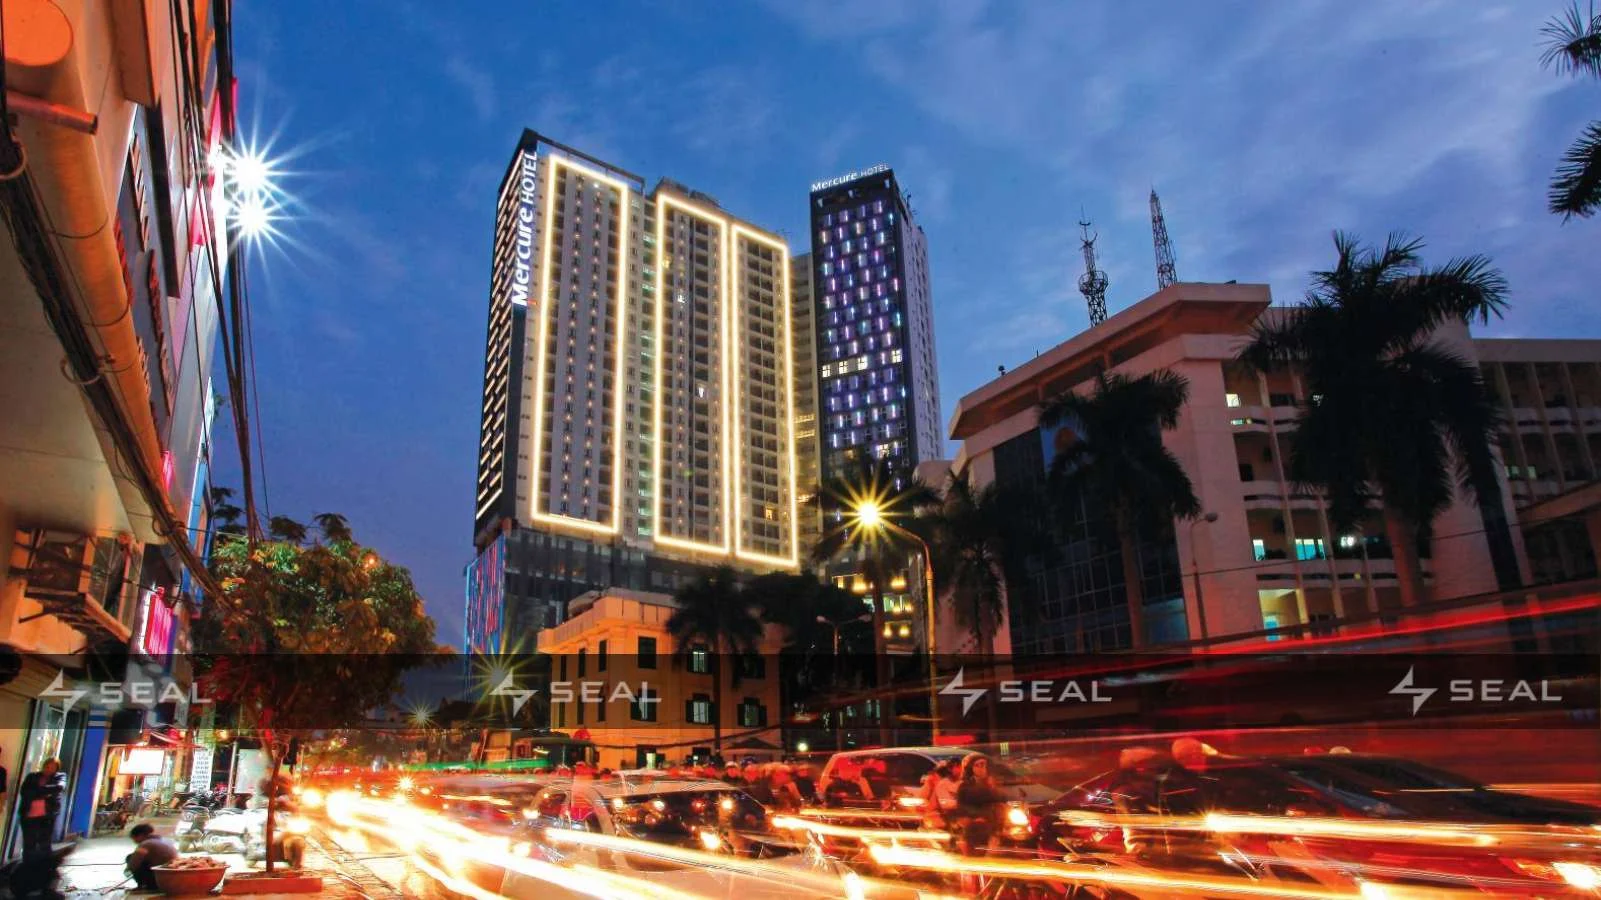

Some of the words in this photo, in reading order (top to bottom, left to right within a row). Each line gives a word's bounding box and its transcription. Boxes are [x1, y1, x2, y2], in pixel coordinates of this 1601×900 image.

[521, 151, 538, 205] HOTEL
[811, 171, 859, 192] Mercure
[860, 163, 890, 177] HOTEL
[511, 207, 534, 306] Mercure
